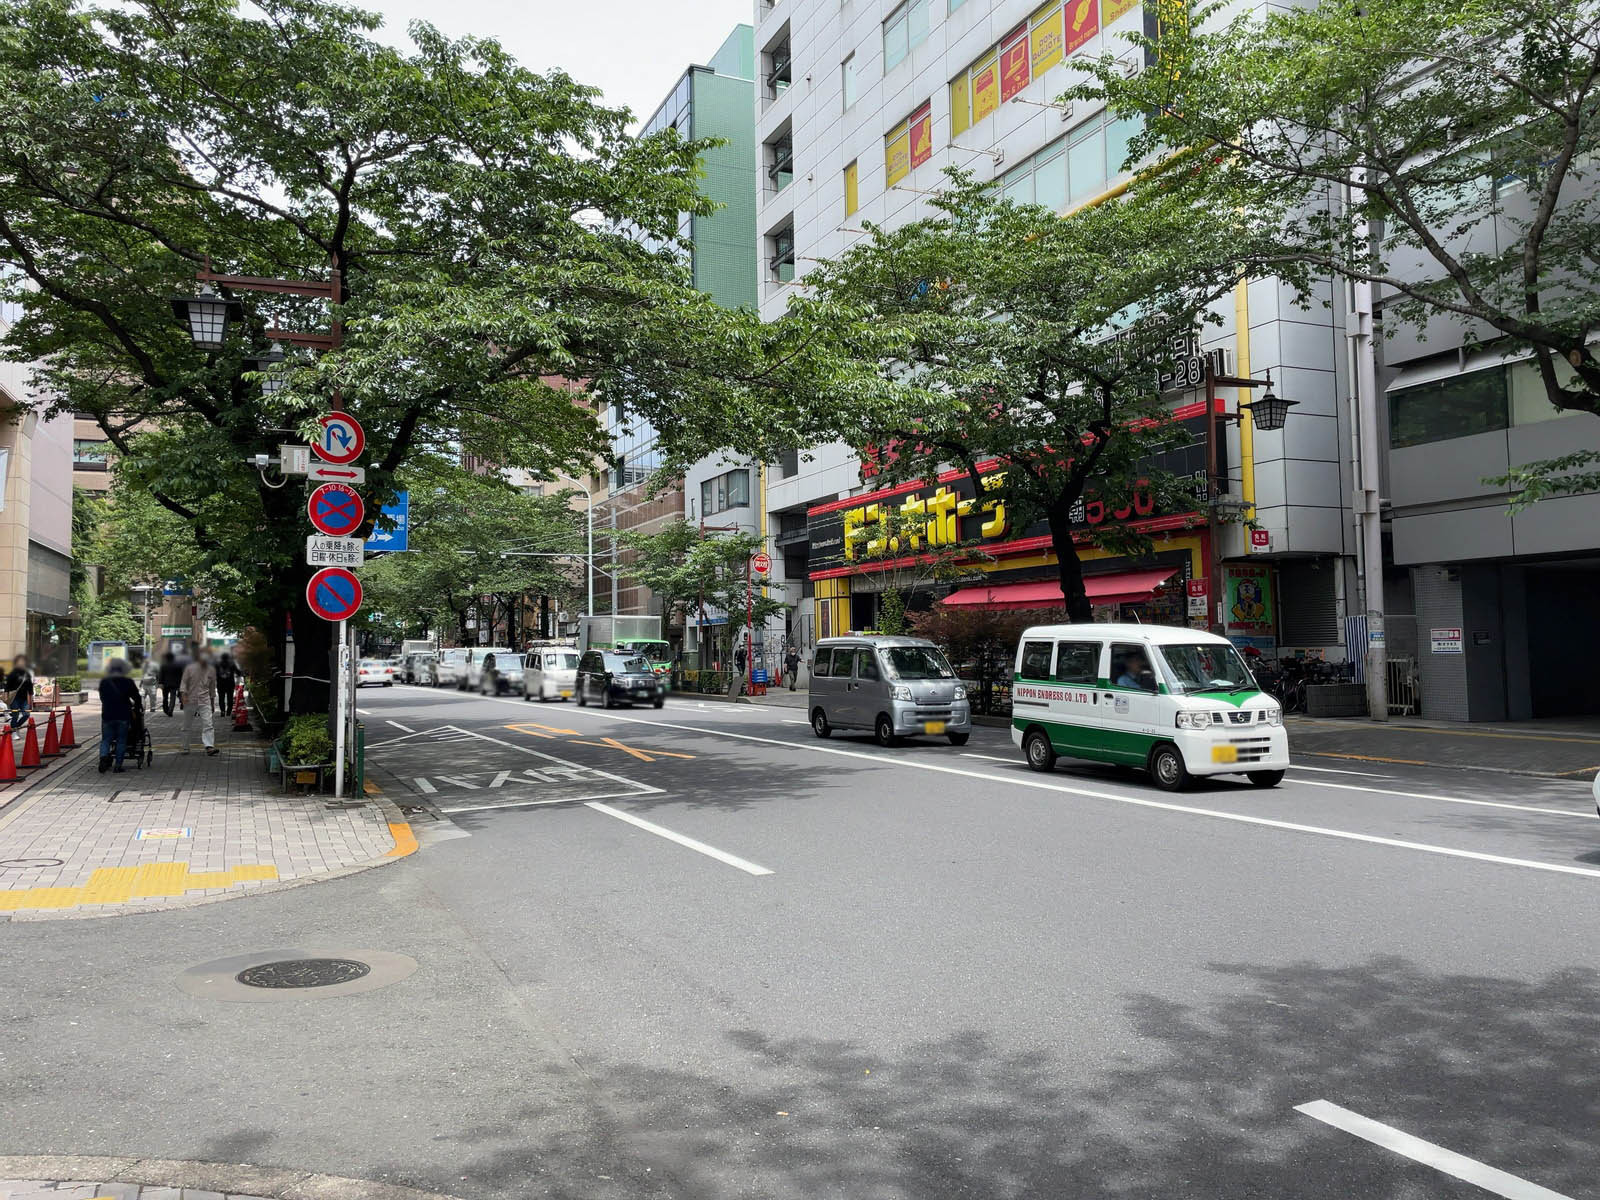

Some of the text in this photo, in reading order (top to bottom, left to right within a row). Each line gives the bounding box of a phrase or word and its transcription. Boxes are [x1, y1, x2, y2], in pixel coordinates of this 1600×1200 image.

[1039, 31, 1053, 47] DON
[312, 541, 360, 552] 人の乗降を除く
[1016, 687, 1037, 699] NIPPON
[1037, 689, 1064, 701] ENDRESS
